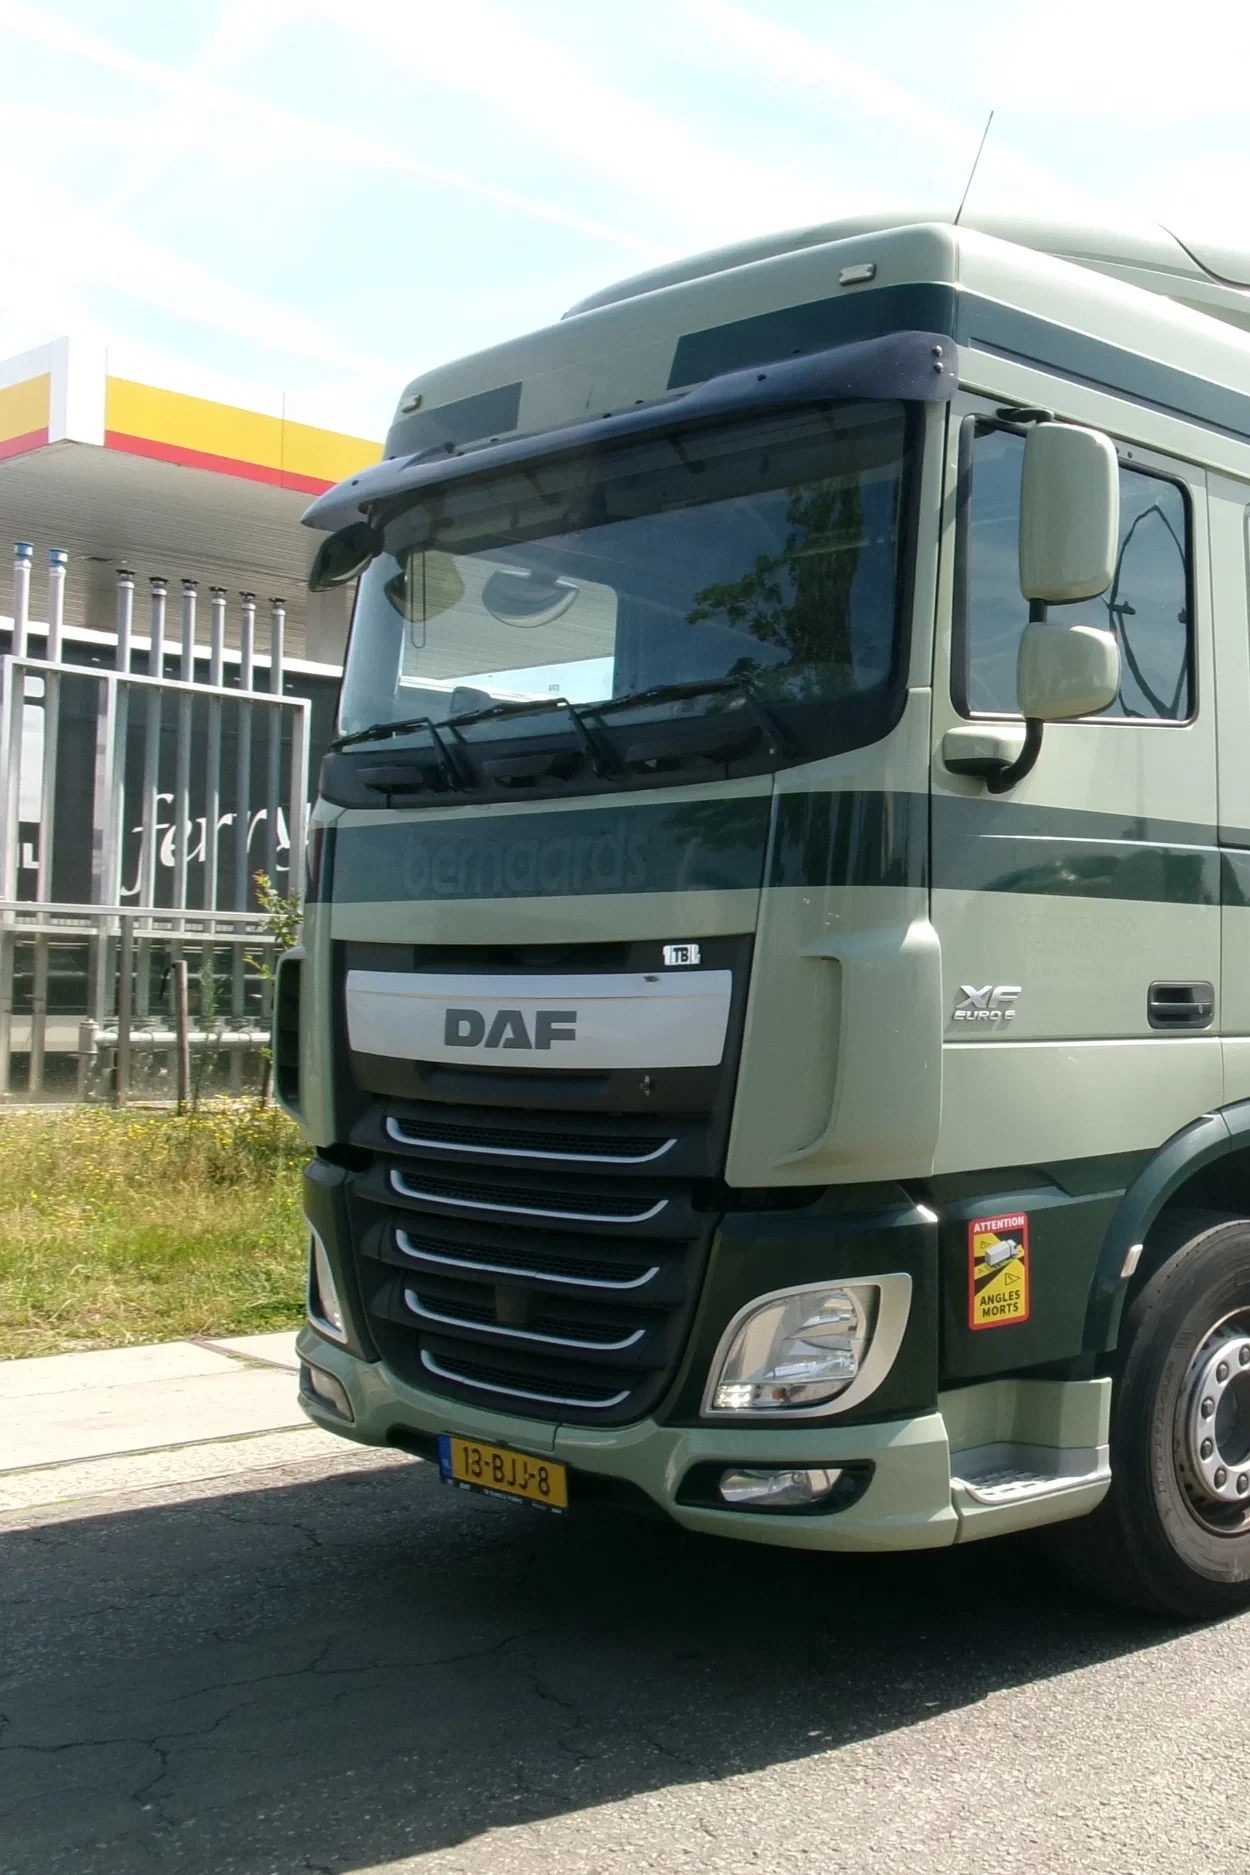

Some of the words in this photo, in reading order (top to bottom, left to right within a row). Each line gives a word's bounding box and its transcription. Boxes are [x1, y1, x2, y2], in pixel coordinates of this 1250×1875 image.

[673, 947, 689, 962] TB
[955, 985, 1022, 1008] XF
[953, 1010, 1002, 1021] EURO
[444, 1008, 577, 1050] DAF
[973, 1216, 1025, 1233] ATTENTION
[980, 1290, 1021, 1307] ANGLES
[982, 1302, 1019, 1318] MORTS
[462, 1446, 550, 1496] 13-BJJ-8
